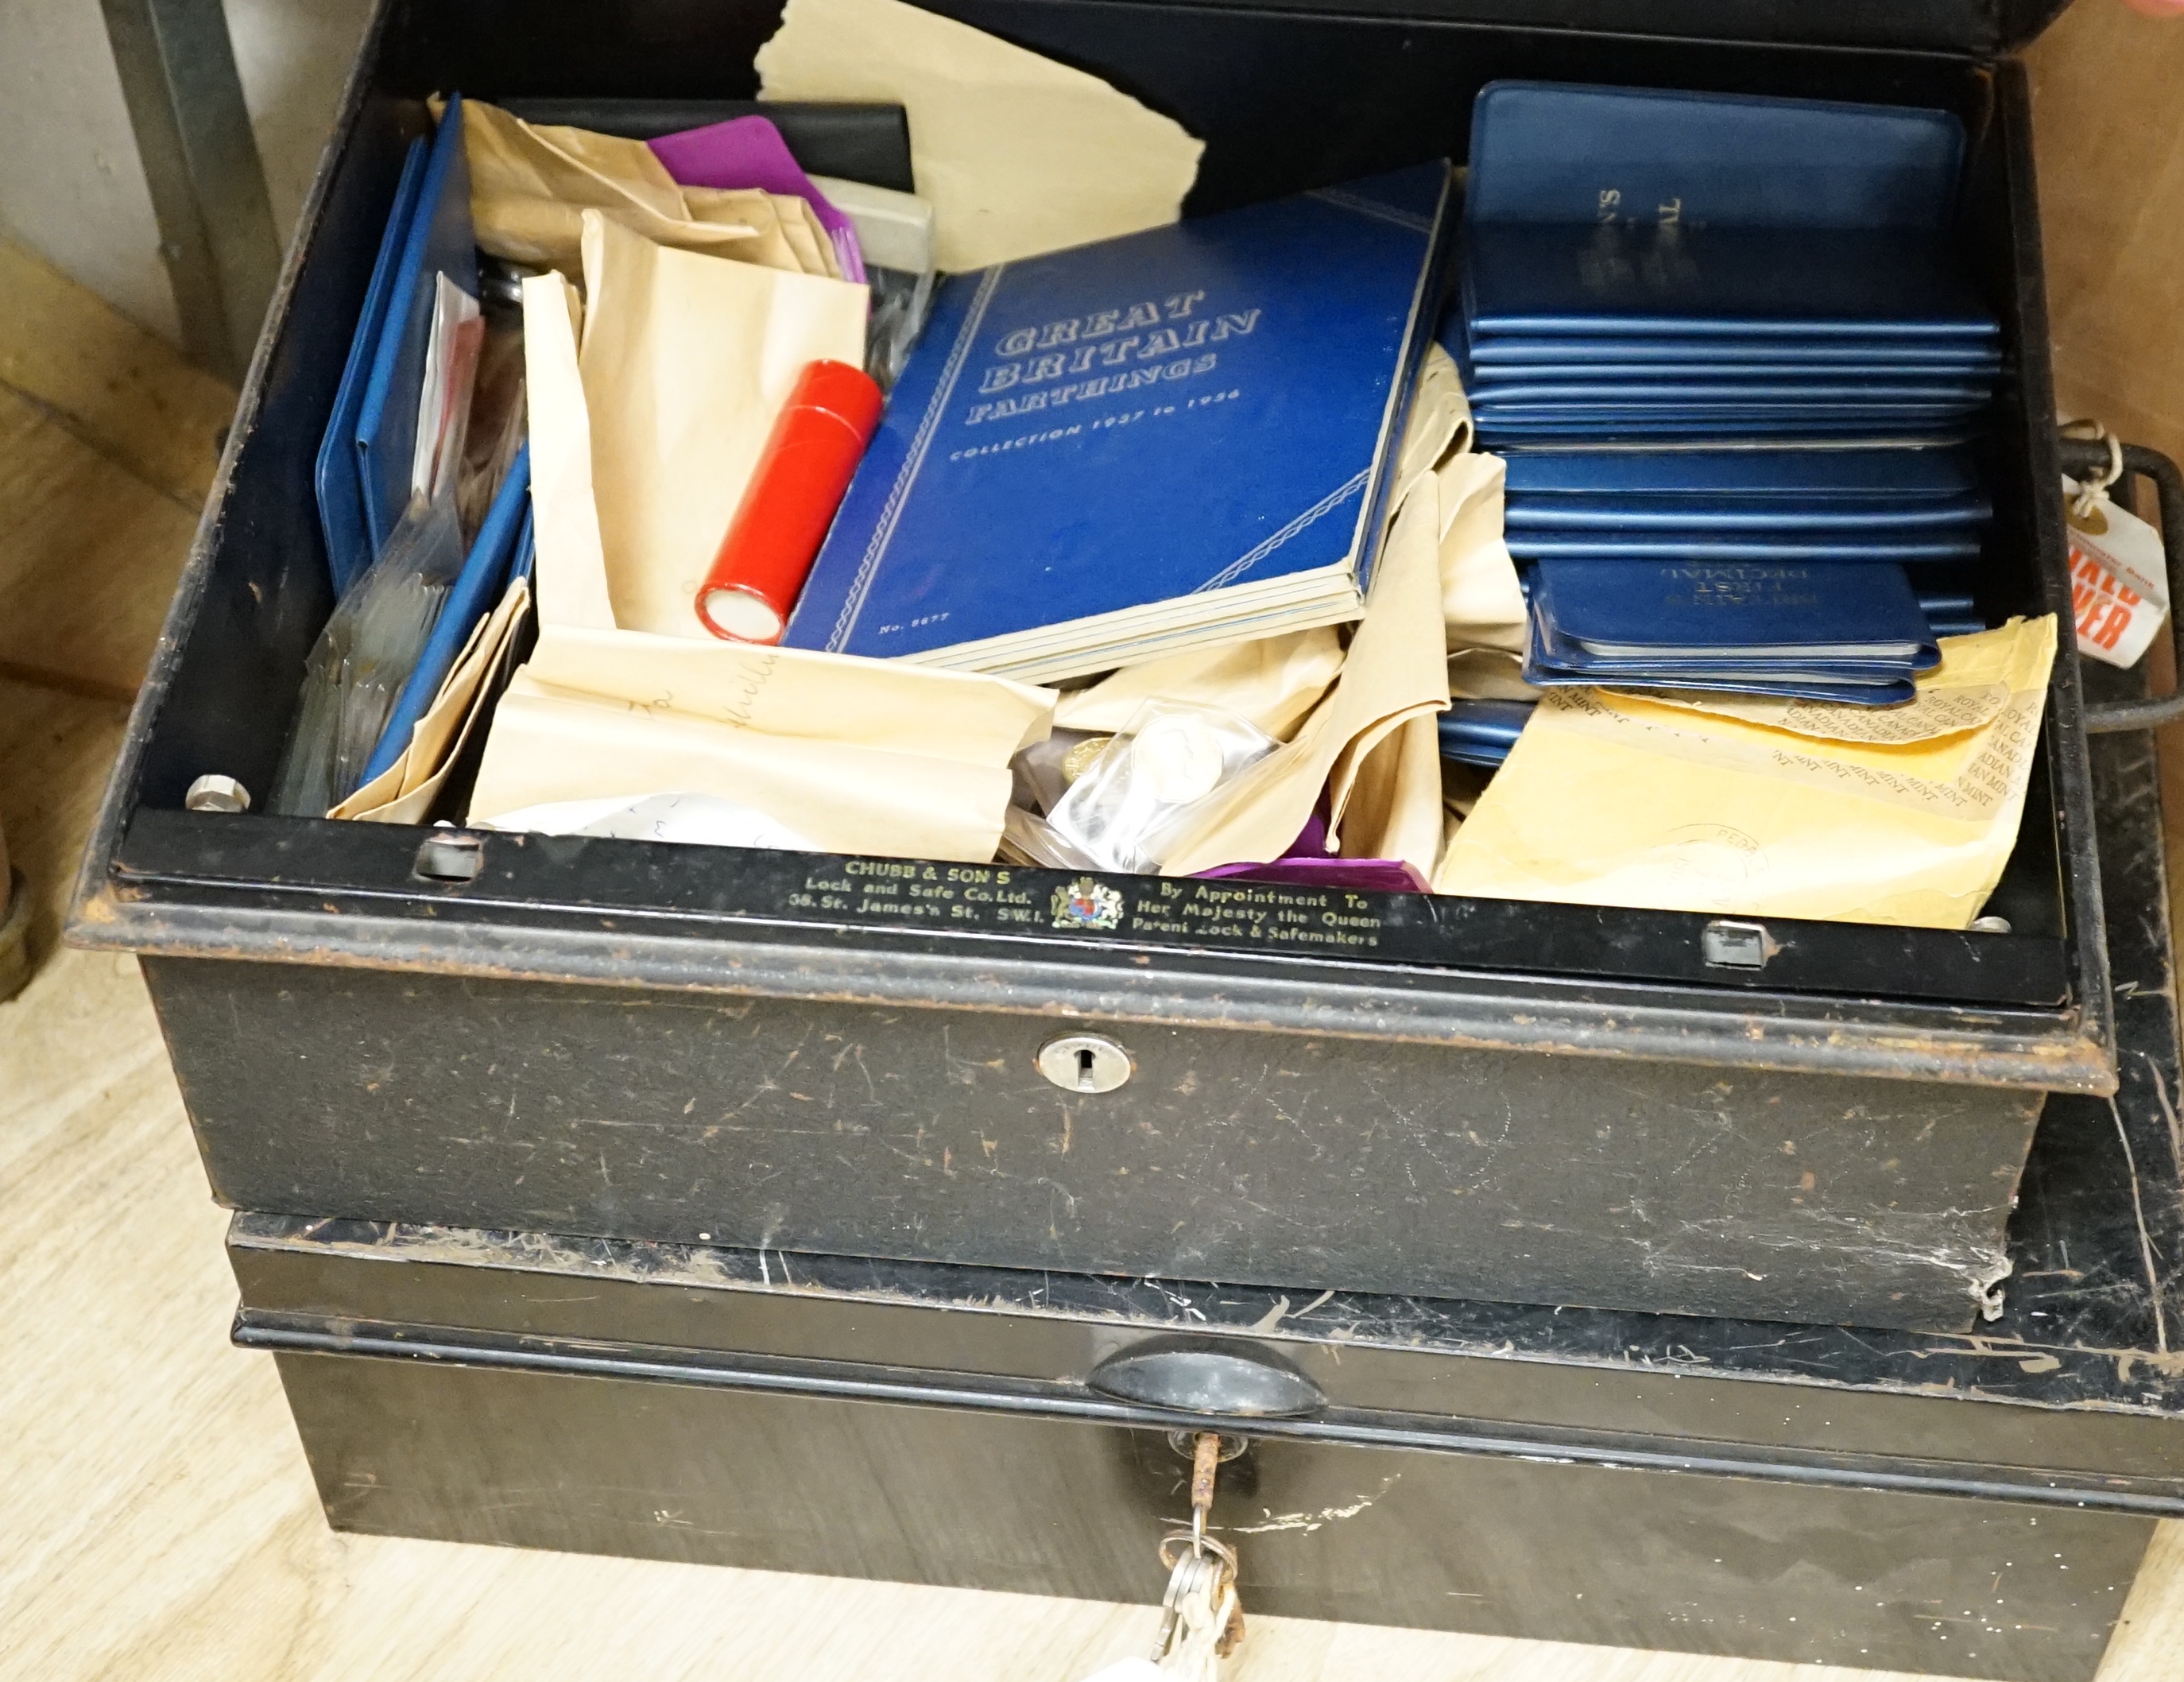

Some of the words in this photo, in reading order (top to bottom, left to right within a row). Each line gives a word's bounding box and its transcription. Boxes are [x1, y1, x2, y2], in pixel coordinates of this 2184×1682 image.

[996, 290, 1205, 356] GREAT
[978, 308, 1262, 393] BRITAIN
[965, 353, 1217, 426] FARTHINGS
[950, 424, 1082, 462] COLLECTION
[1092, 410, 1144, 430] 1937
[878, 625, 904, 635] No.
[1934, 783, 1968, 808] MINT
[845, 860, 916, 879] CHUBB
[922, 866, 938, 881] &
[805, 877, 852, 893] Lock
[863, 883, 899, 895] and
[909, 884, 955, 900] Safe
[964, 887, 993, 902] Co.
[996, 889, 1032, 905] Ltd.
[1160, 882, 1183, 900] By
[1195, 885, 1328, 908] Appointment
[1345, 894, 1368, 910] To
[951, 905, 980, 920] St.
[1137, 900, 1171, 917] Her
[1182, 902, 1268, 924] Majesty
[1277, 909, 1309, 924] the
[1321, 912, 1381, 928] Queen
[1132, 917, 1189, 934] Patent
[1249, 925, 1262, 939] &
[1268, 926, 1379, 948] Safemakers
